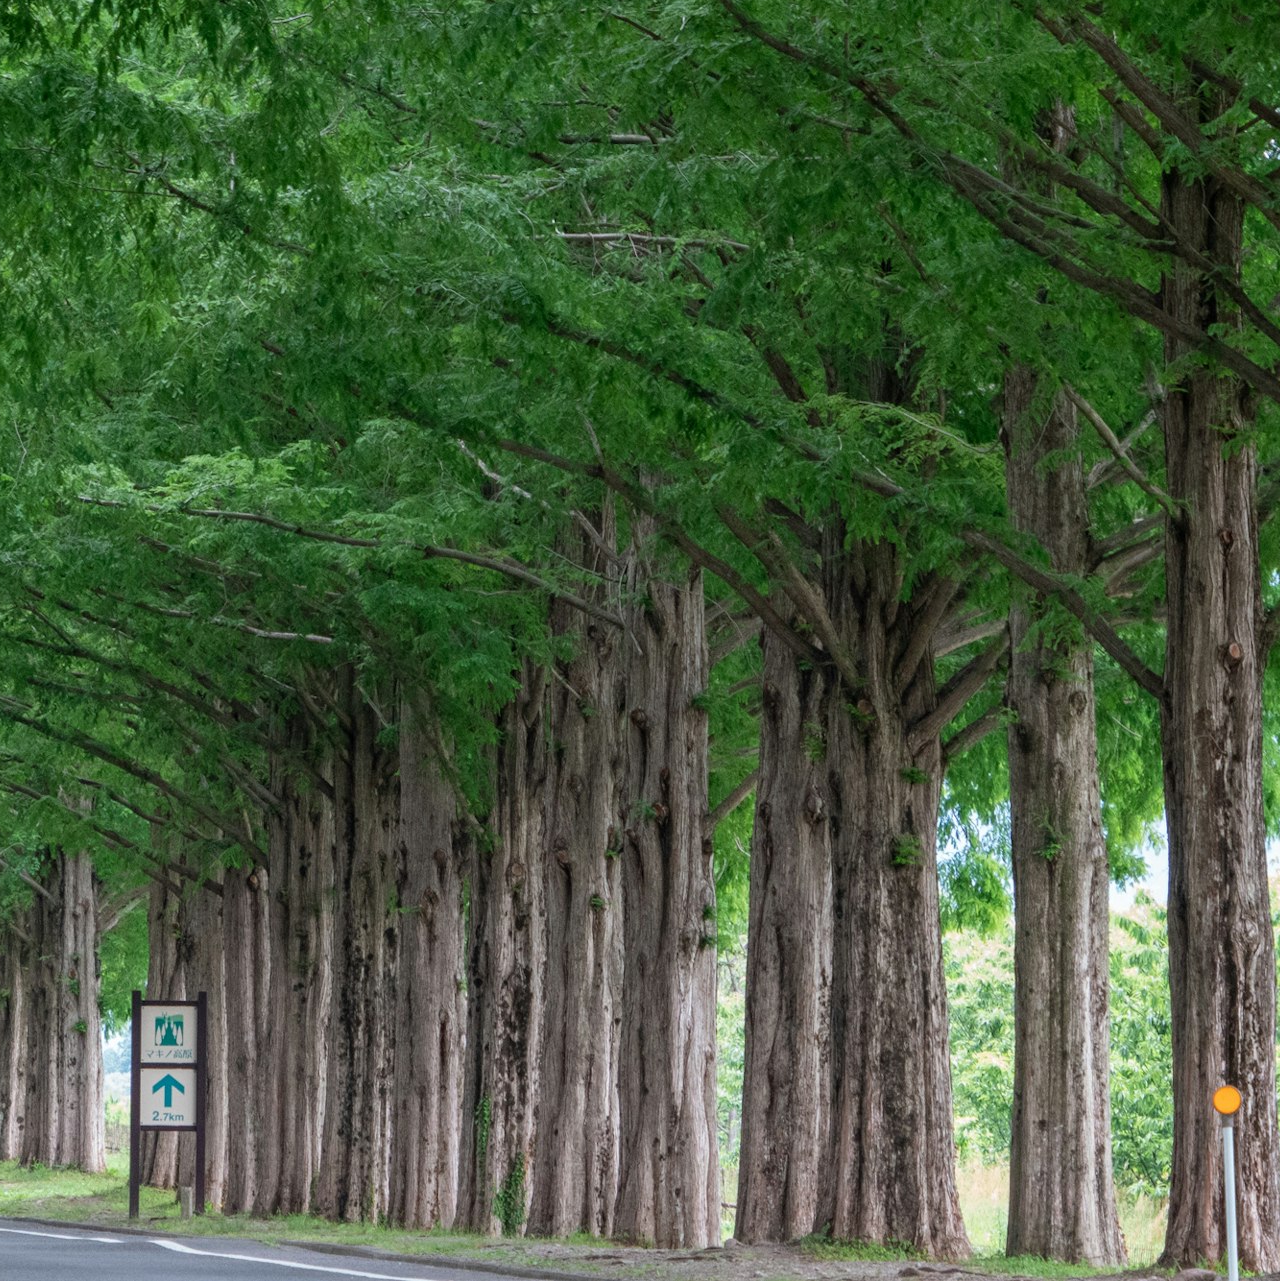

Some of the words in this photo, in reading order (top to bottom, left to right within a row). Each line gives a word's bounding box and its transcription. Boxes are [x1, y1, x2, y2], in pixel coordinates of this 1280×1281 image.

[145, 1049, 193, 1059] マキノ高原
[152, 1110, 184, 1121] 2.7km
